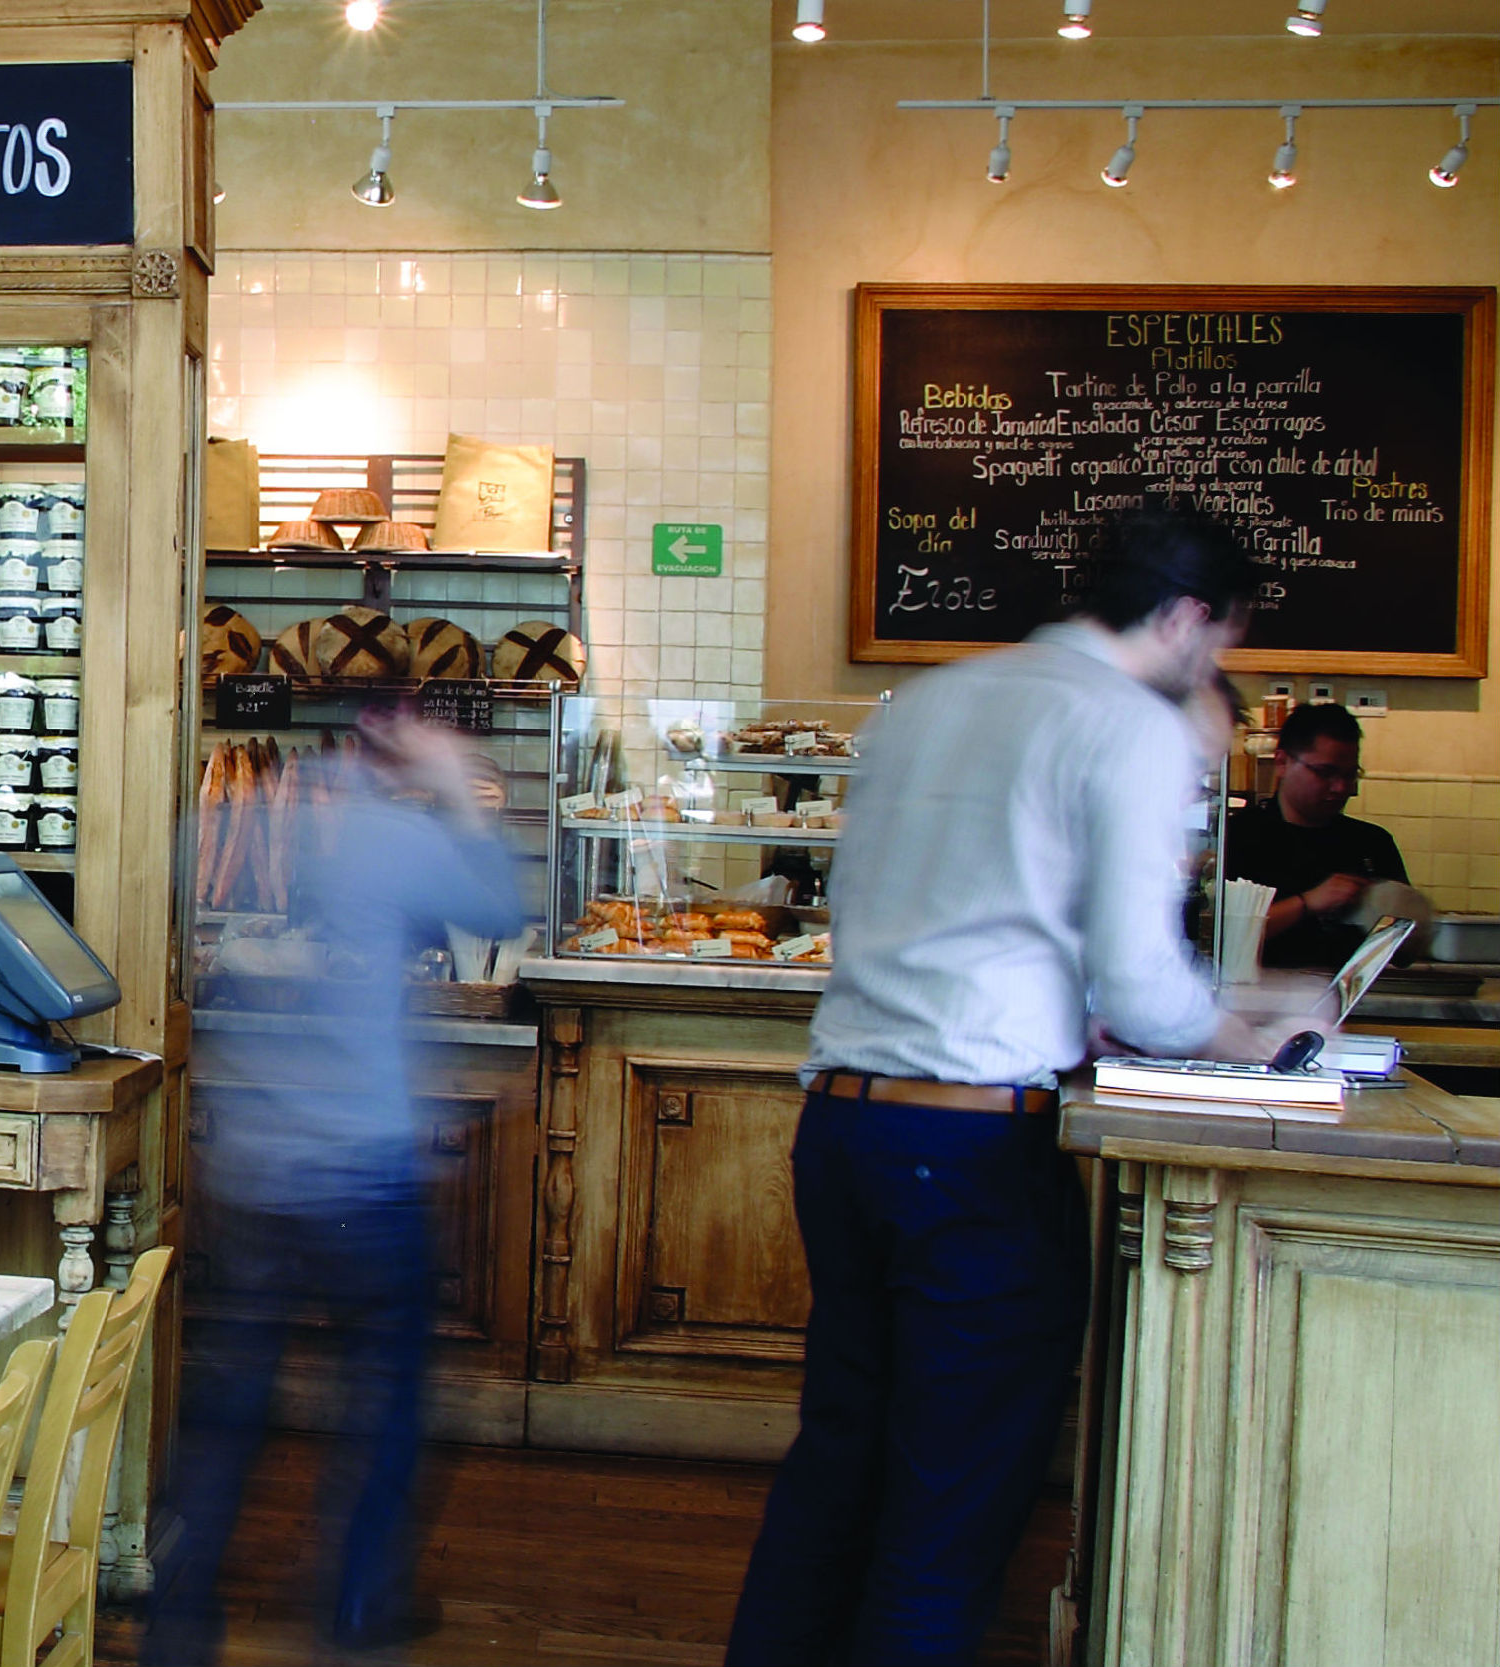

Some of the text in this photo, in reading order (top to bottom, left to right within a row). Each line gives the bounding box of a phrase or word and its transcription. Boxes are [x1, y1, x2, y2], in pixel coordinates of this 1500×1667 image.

[1107, 314, 1284, 347] ESPECIALES
[1152, 347, 1237, 371] Platillos
[924, 384, 1013, 411] Bebidas
[1045, 367, 1321, 401] Tartine de Pollo a la parrilla
[1162, 400, 1170, 414] y
[900, 407, 1057, 436] Refresco de Jamaica
[1057, 410, 1139, 436] Ensalada
[972, 450, 1062, 486] Spaguetti
[1229, 459, 1262, 474] con
[1312, 450, 1331, 474] de
[1353, 471, 1428, 499] Postres
[889, 507, 976, 534] Sopa del
[1321, 500, 1444, 522] Trio de minis
[994, 525, 1078, 549] Sandwich
[1254, 526, 1322, 555] Parrilla
